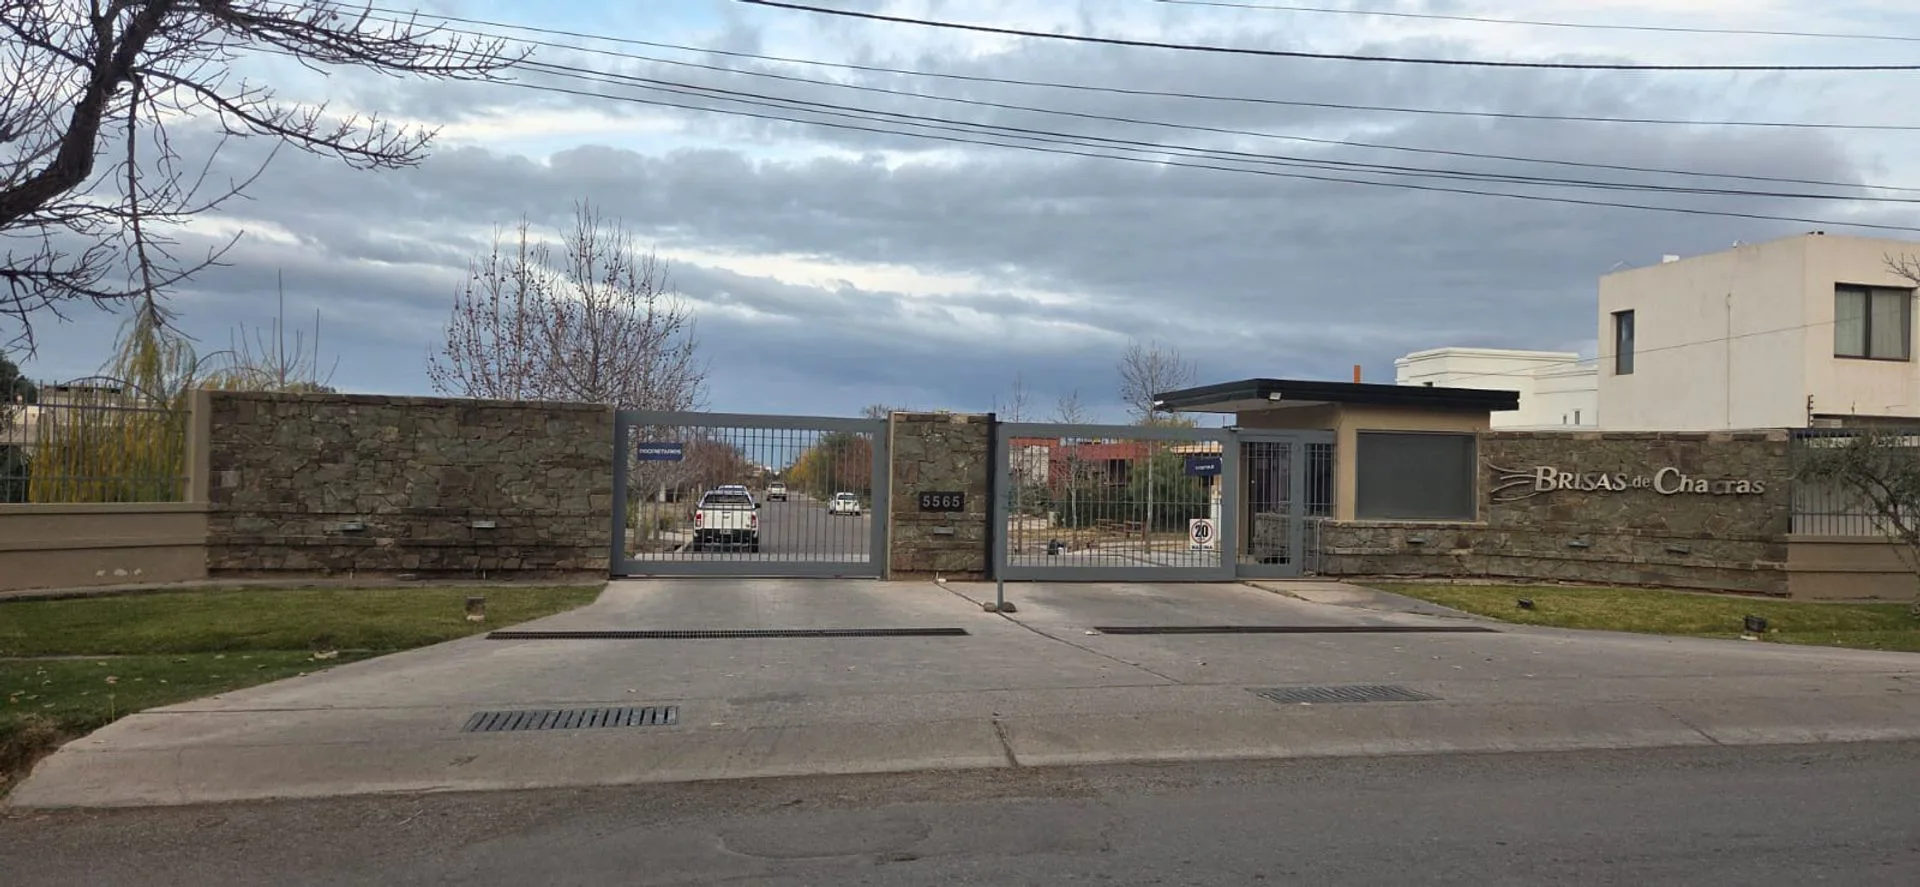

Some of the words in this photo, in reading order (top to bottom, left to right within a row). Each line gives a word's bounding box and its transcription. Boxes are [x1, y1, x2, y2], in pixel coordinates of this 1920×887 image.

[1535, 465, 1628, 491] BRISAS
[1632, 474, 1650, 488] de
[1654, 466, 1766, 494] Chacras
[922, 495, 960, 508] 5565
[1195, 524, 1208, 537] 20
